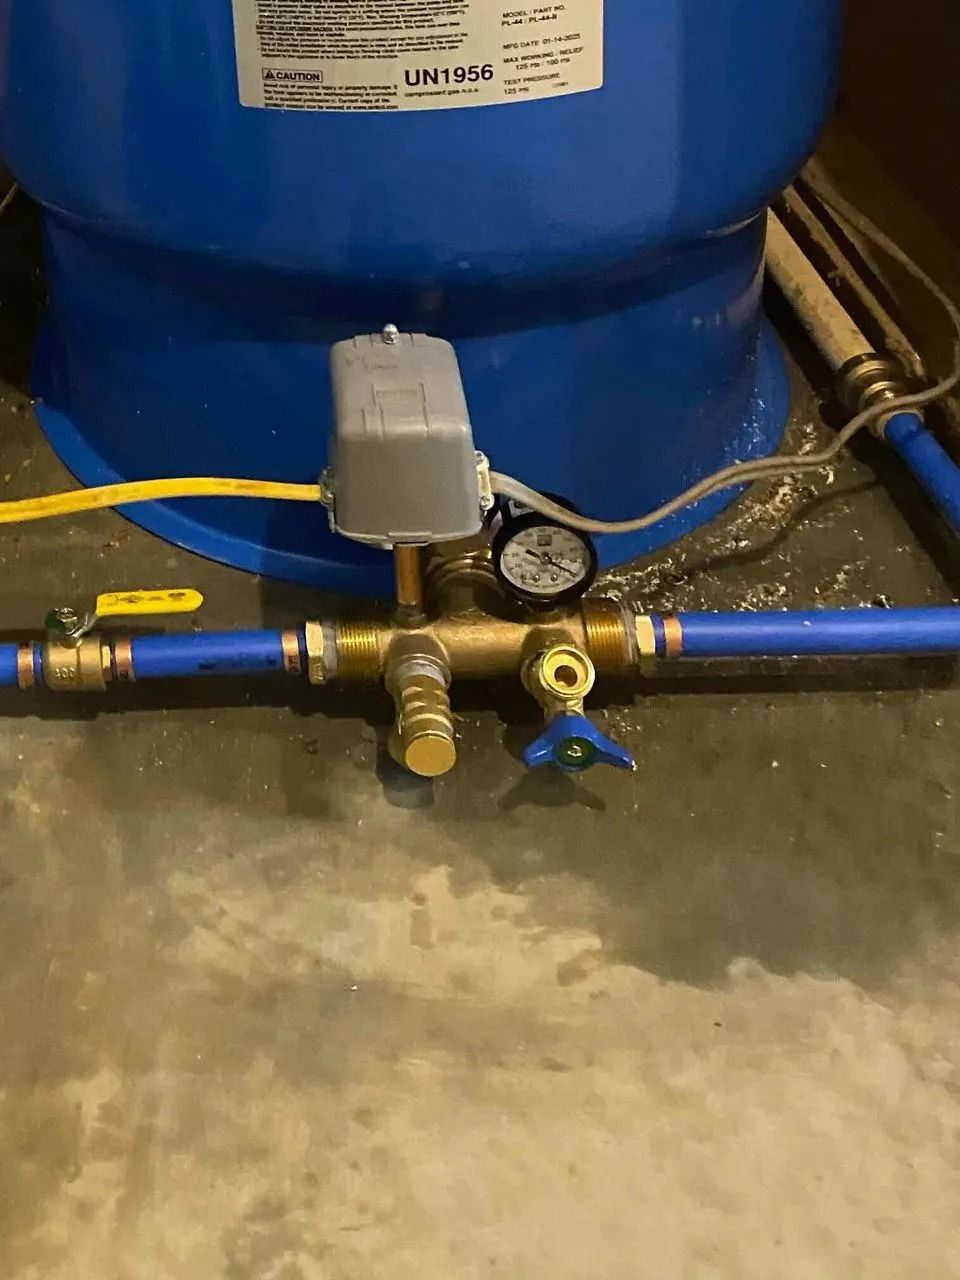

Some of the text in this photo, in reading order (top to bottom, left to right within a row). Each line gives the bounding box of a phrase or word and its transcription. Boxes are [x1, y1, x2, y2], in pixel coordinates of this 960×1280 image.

[502, 10, 528, 18] MODEL
[533, 6, 553, 14] PART
[520, 40, 539, 48] DATE
[276, 72, 320, 81] CAUTION
[404, 63, 494, 86] UN1956
